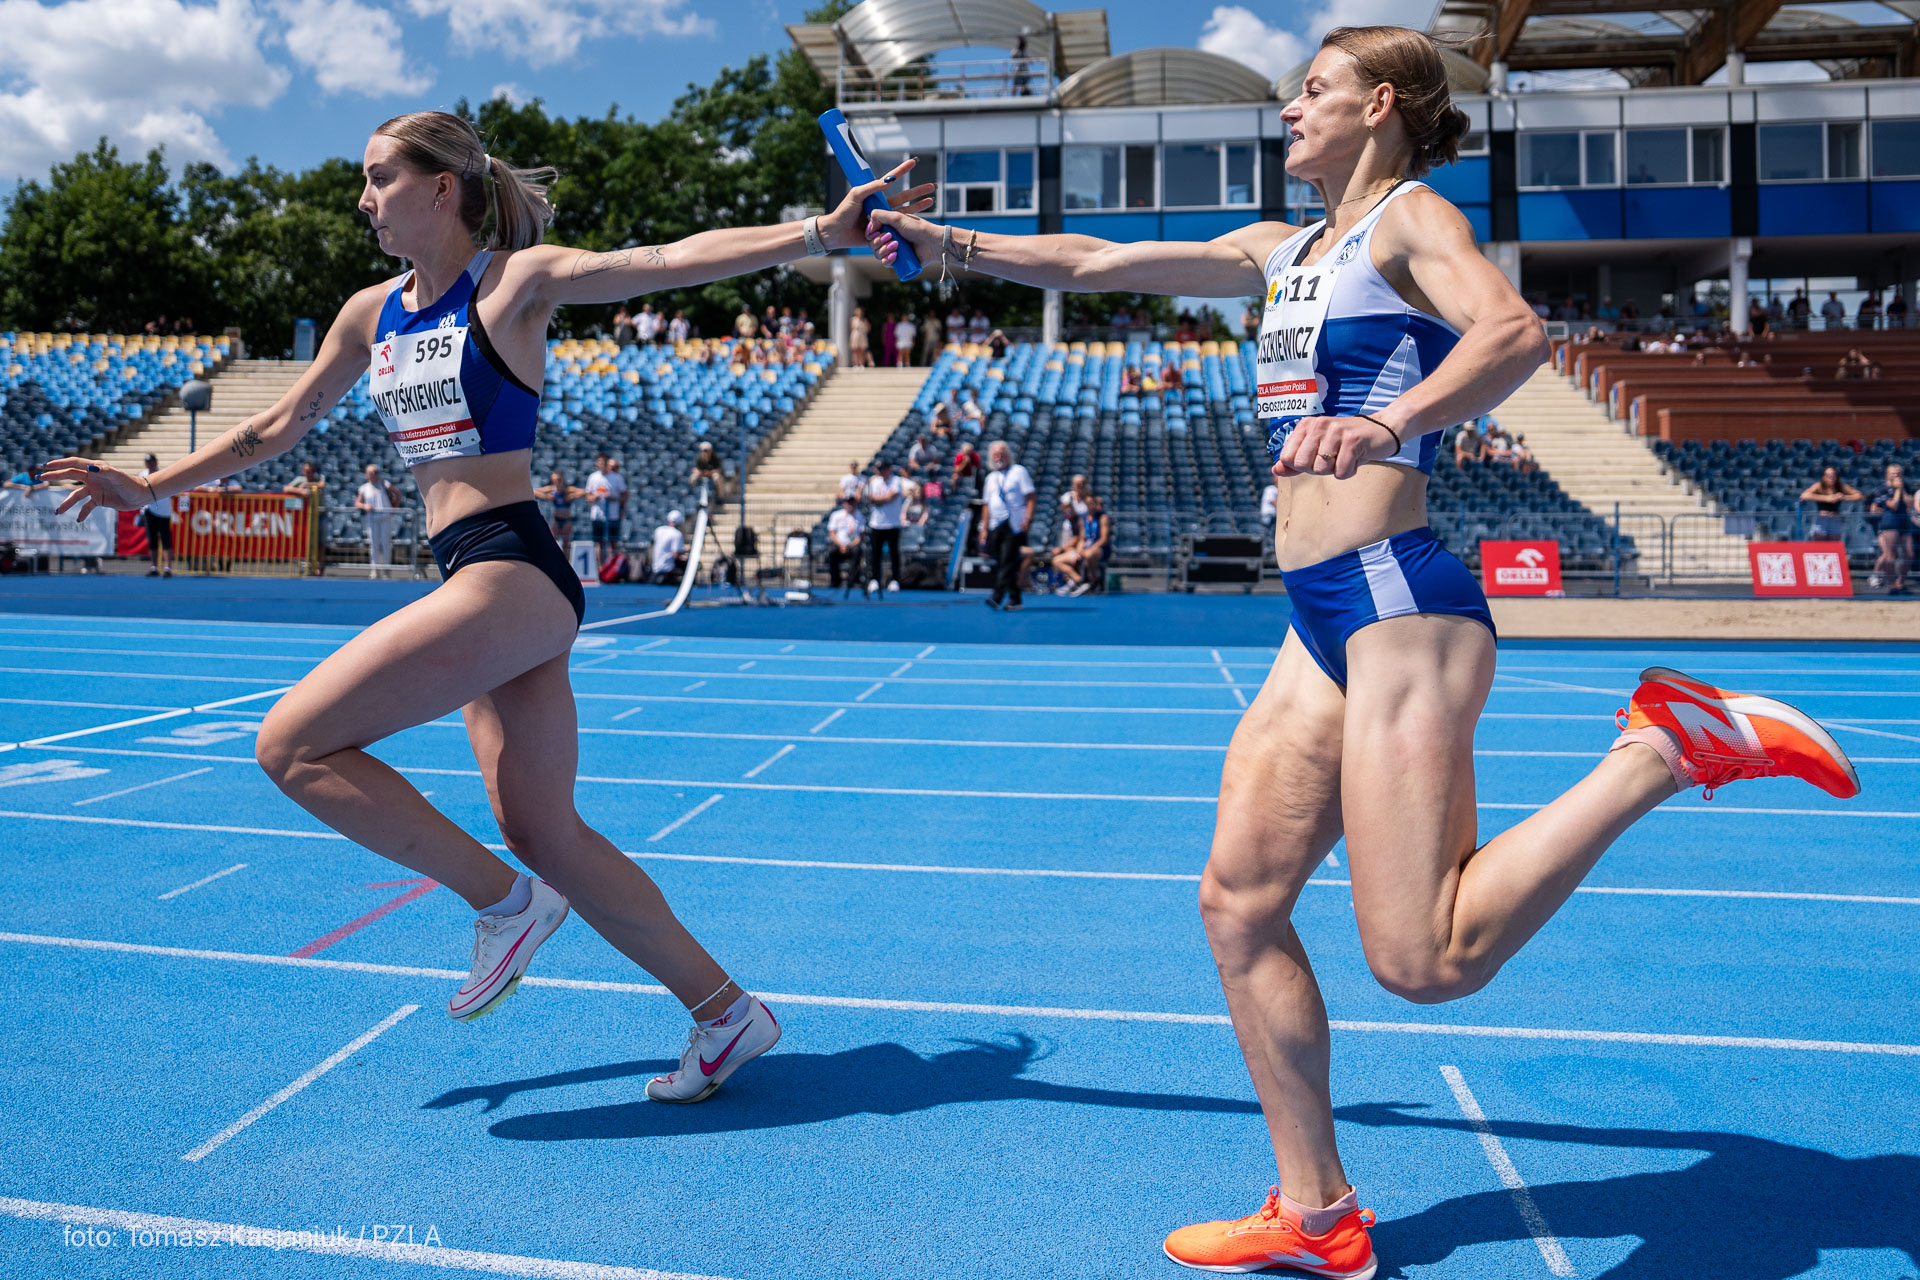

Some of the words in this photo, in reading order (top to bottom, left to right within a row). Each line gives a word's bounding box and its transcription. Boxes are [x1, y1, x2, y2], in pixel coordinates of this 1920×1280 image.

[415, 334, 453, 364] 595
[378, 364, 395, 377] ORLEN
[1292, 381, 1307, 392] Polski
[1287, 398, 1307, 411] 2024
[440, 424, 457, 434] Polski
[437, 437, 462, 450] 2024
[191, 510, 293, 538] ORLEN
[577, 550, 590, 576] 1
